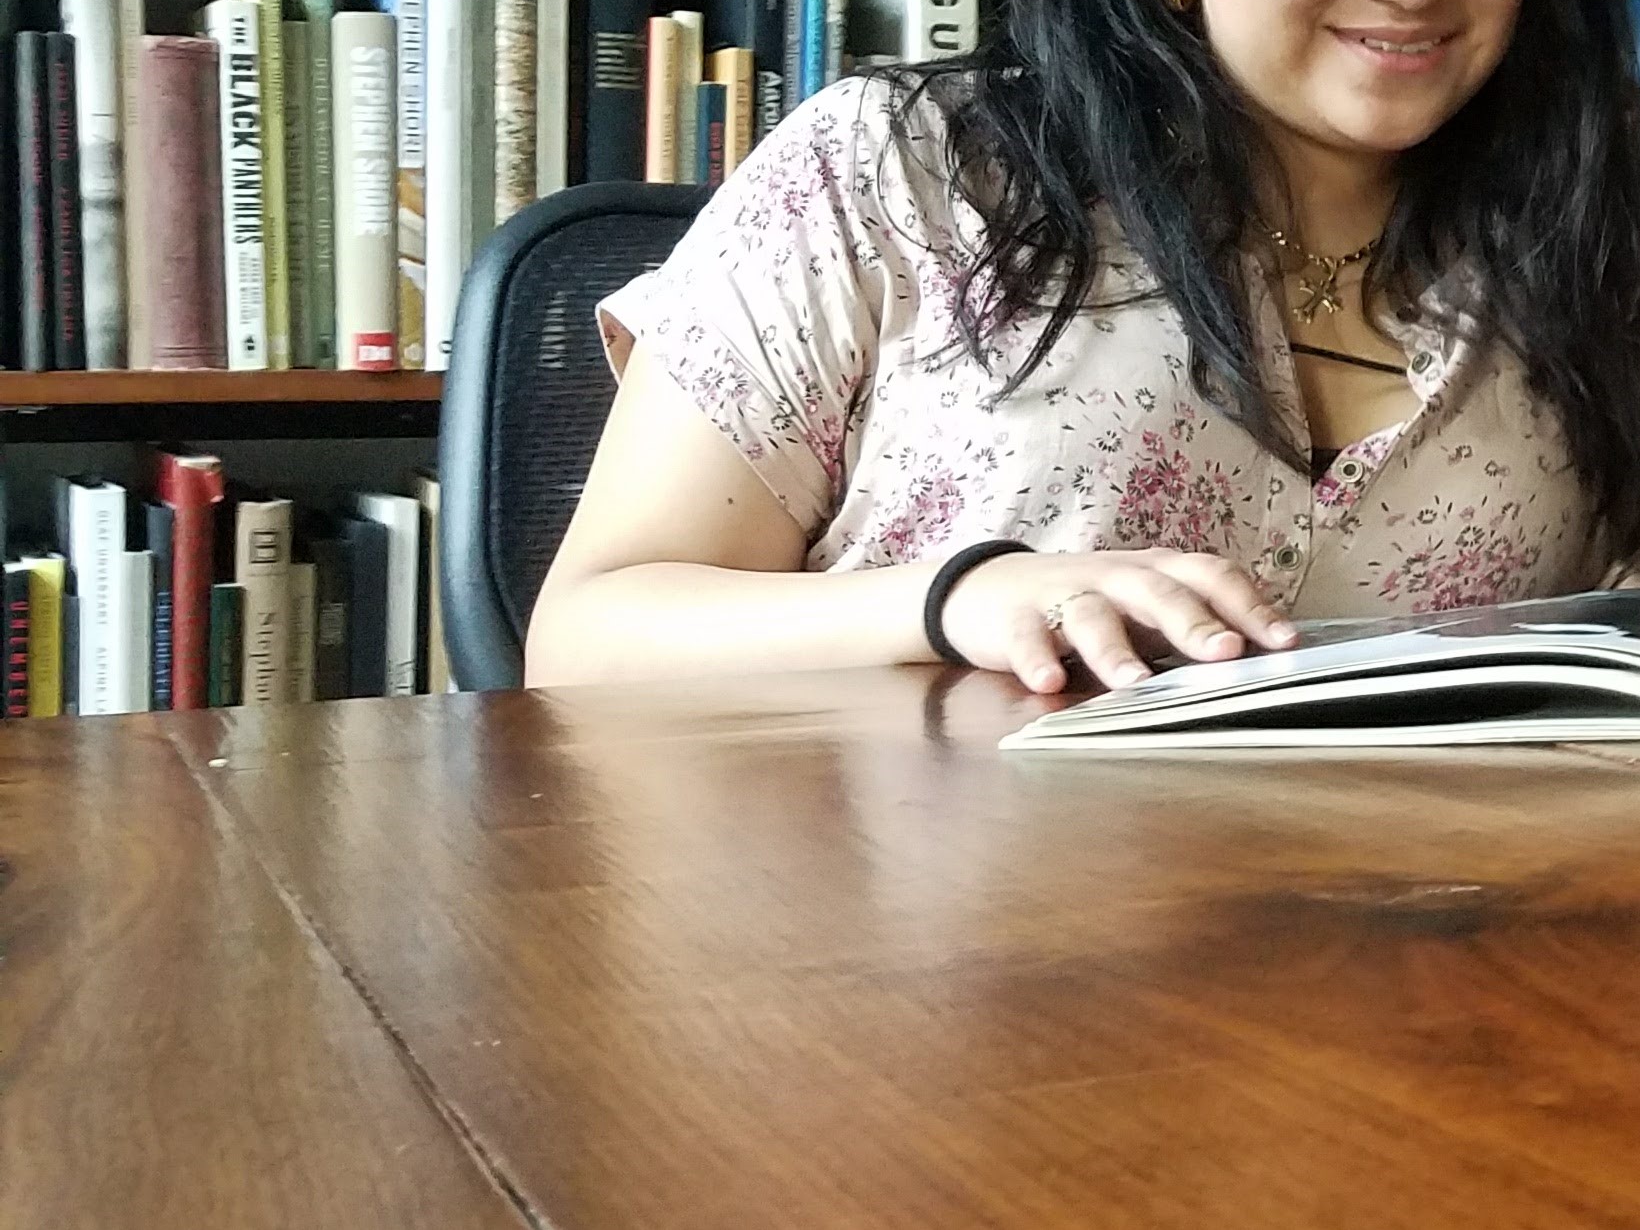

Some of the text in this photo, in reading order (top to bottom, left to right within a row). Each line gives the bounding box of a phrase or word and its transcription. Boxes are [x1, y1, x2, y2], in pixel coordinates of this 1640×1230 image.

[227, 16, 266, 246] THE BLACK PANTHERS
[350, 45, 389, 237] STEPHEN SHORE
[94, 508, 111, 542] OLAF
